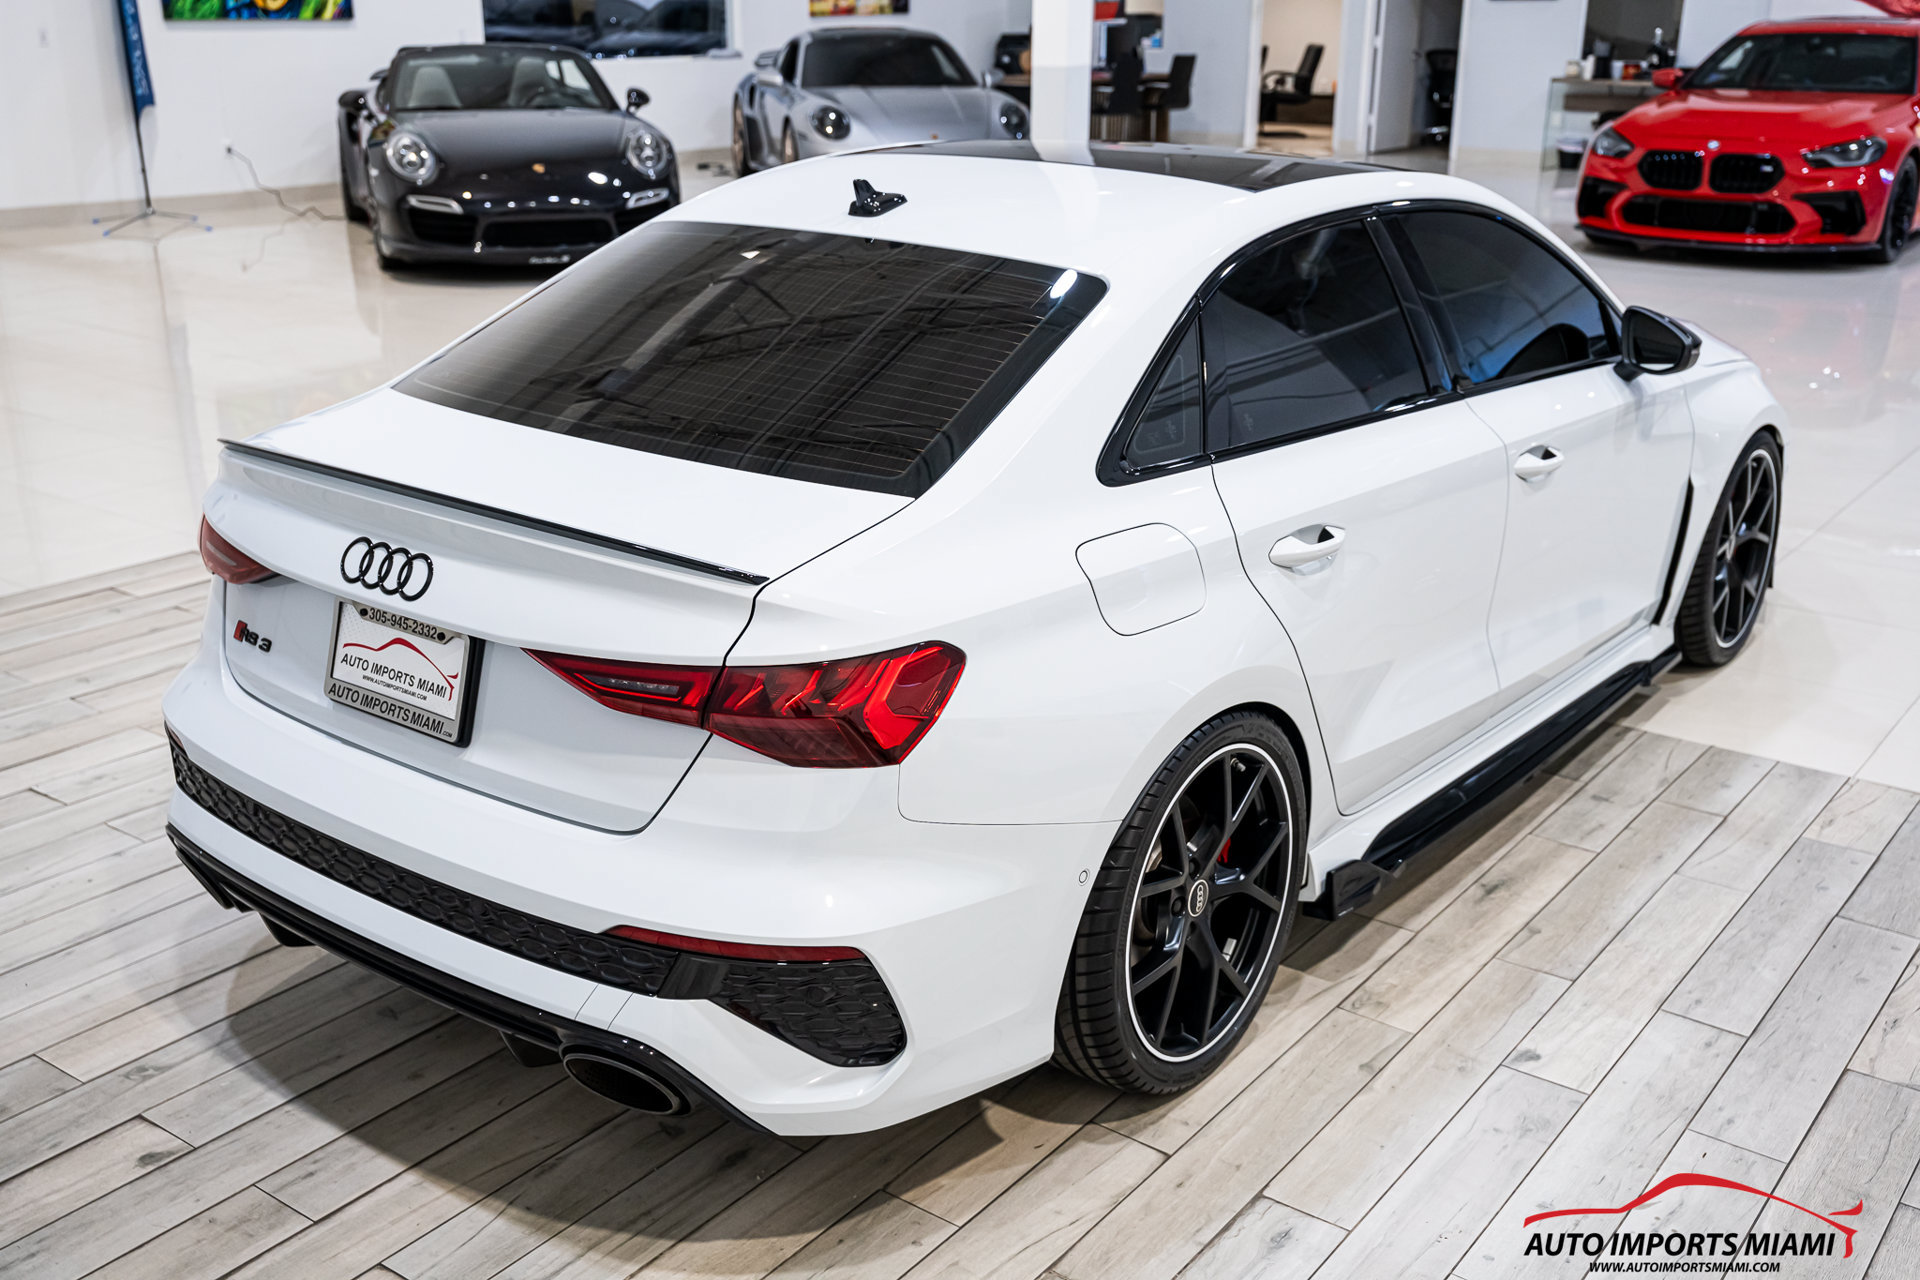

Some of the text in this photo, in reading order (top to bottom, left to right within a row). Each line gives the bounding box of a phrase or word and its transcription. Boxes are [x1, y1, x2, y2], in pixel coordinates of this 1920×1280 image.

[369, 607, 438, 640] 305-945-2332
[340, 653, 447, 698] AUTO IMPORTS MIAMI
[362, 674, 428, 701] WWW.AUTOIMPORTSMIAMI.COM
[328, 682, 360, 703] AUTO
[360, 694, 411, 722] IMPORTS
